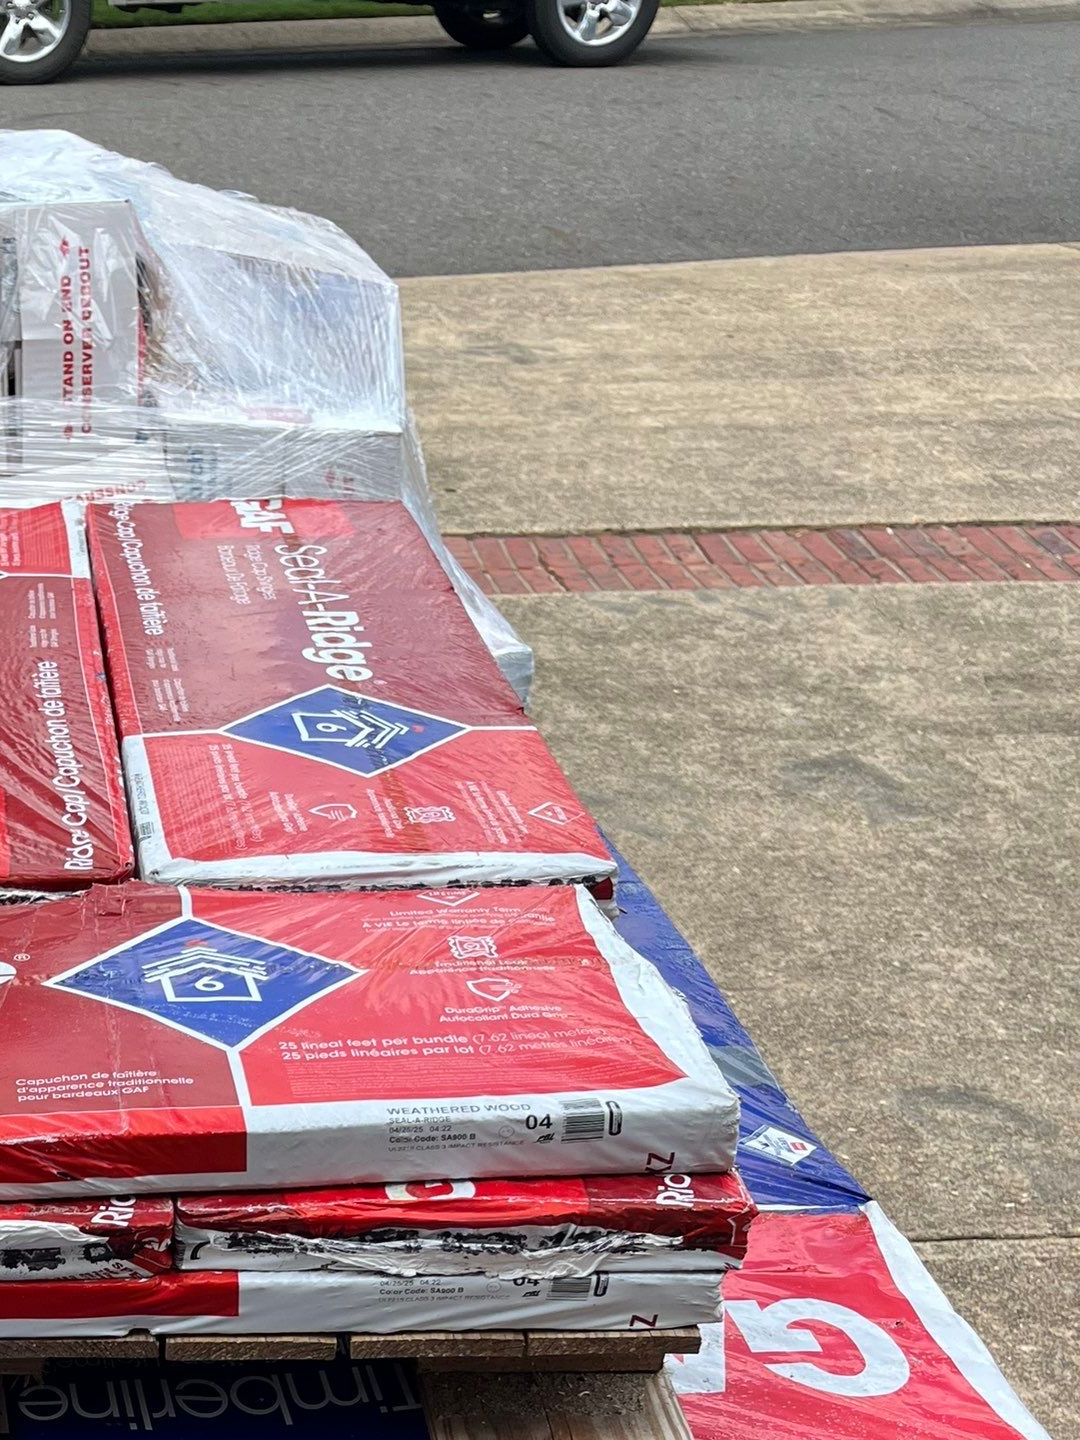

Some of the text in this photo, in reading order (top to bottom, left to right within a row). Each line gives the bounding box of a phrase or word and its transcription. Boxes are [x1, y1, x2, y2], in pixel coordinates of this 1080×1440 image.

[63, 320, 74, 350] ON
[193, 973, 226, 993] 6
[510, 1004, 562, 1013] Adhesive
[279, 1041, 297, 1050] 25
[301, 1039, 342, 1049] lineal
[346, 1038, 379, 1048] feet
[382, 1037, 408, 1048] per
[412, 1034, 468, 1045] bundle
[282, 1051, 301, 1061] 25
[305, 1049, 348, 1061] pieds
[422, 1046, 450, 1058] par
[454, 1044, 474, 1054] lot
[16, 1073, 88, 1086] Capuchon
[91, 1071, 109, 1079] de
[17, 1087, 149, 1103] pour bardeaux GAF
[387, 1103, 531, 1116] WEATHERED WOOD
[524, 1114, 553, 1130] 04
